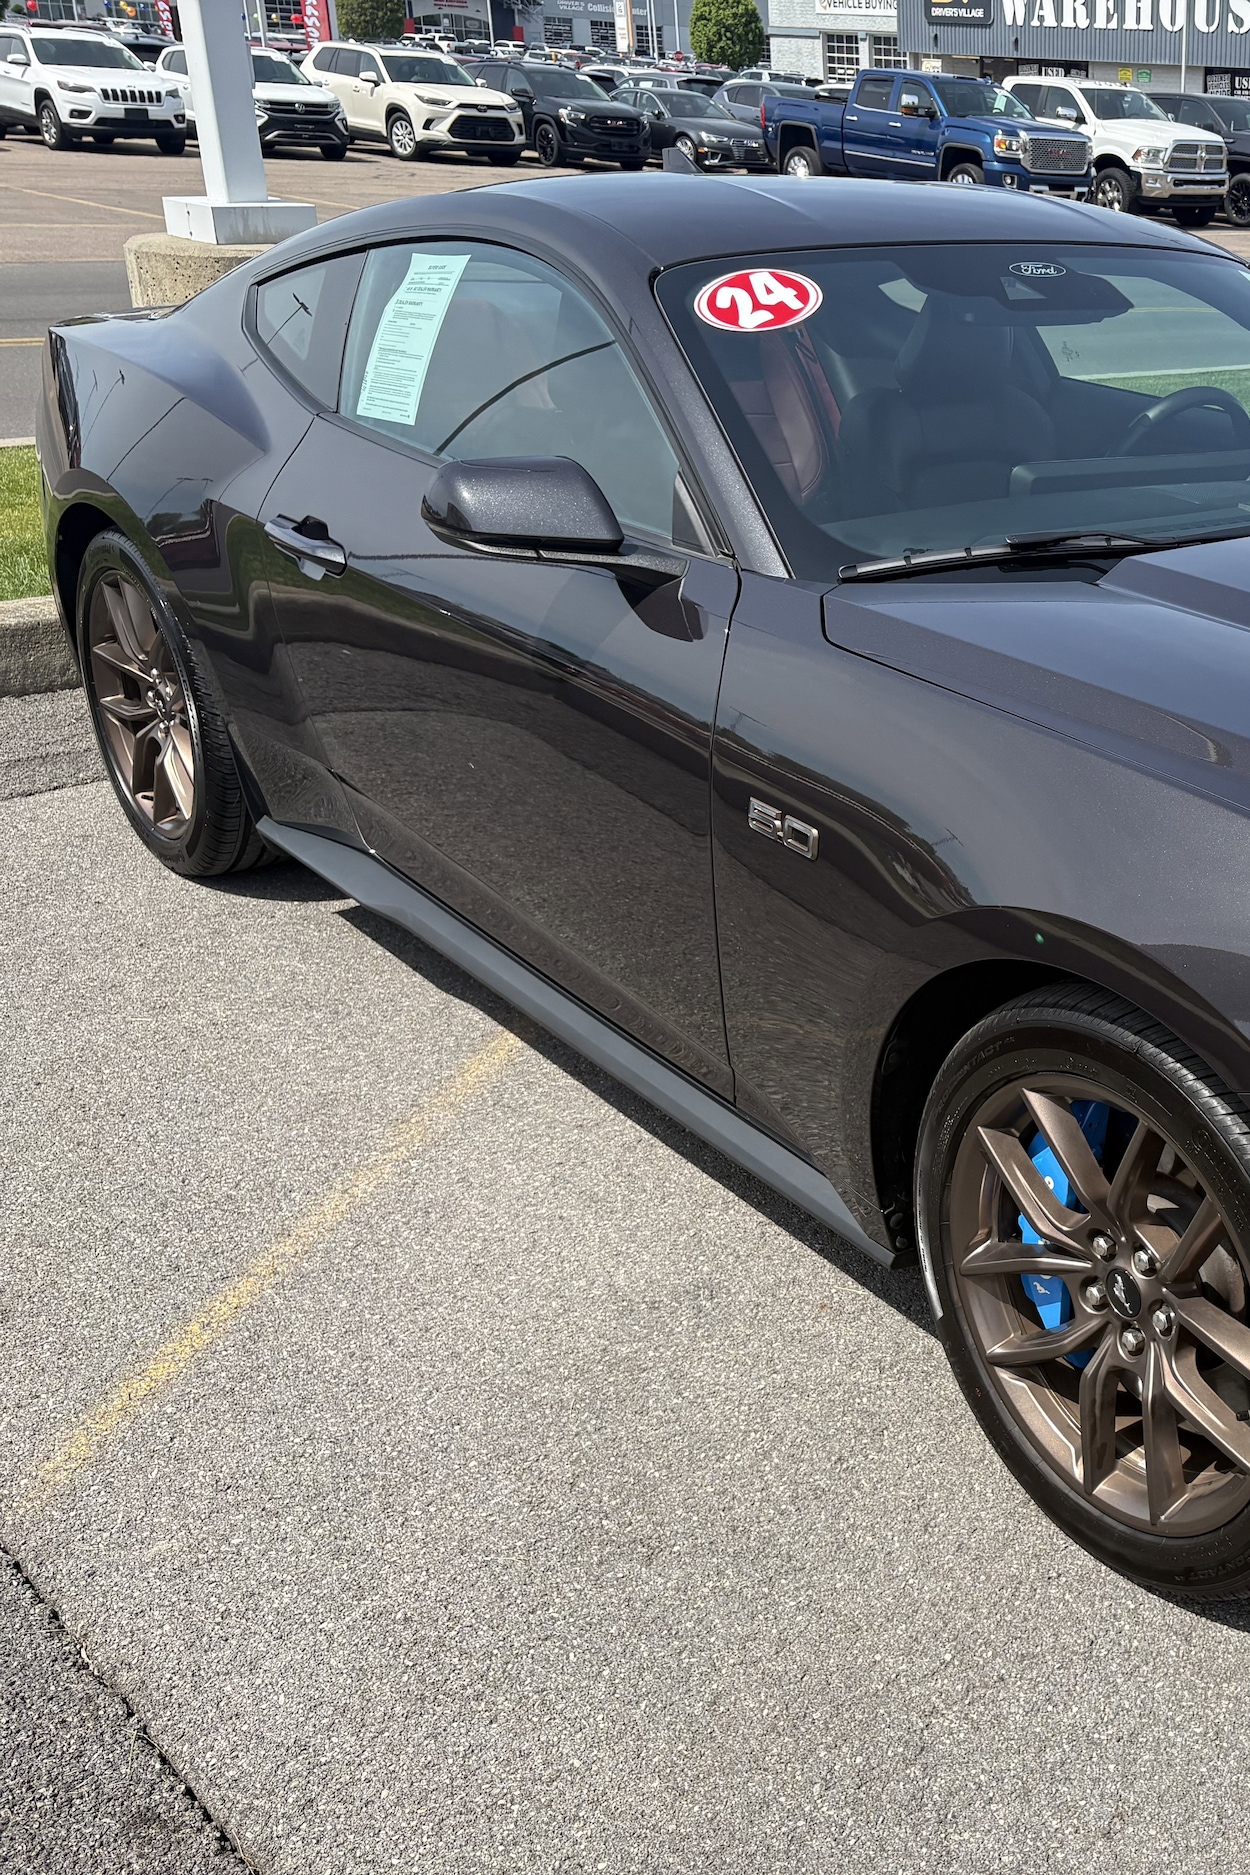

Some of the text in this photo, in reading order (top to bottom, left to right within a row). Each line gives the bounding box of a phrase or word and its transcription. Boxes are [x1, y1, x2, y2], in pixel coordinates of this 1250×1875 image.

[587, 3, 614, 12] Collisi
[827, 0, 864, 9] VEHICLE
[958, 8, 984, 18] VILLAGE
[1042, 67, 1065, 77] USED
[1021, 265, 1058, 275] Ford
[715, 271, 805, 329] 24
[748, 796, 819, 860] 5.0
